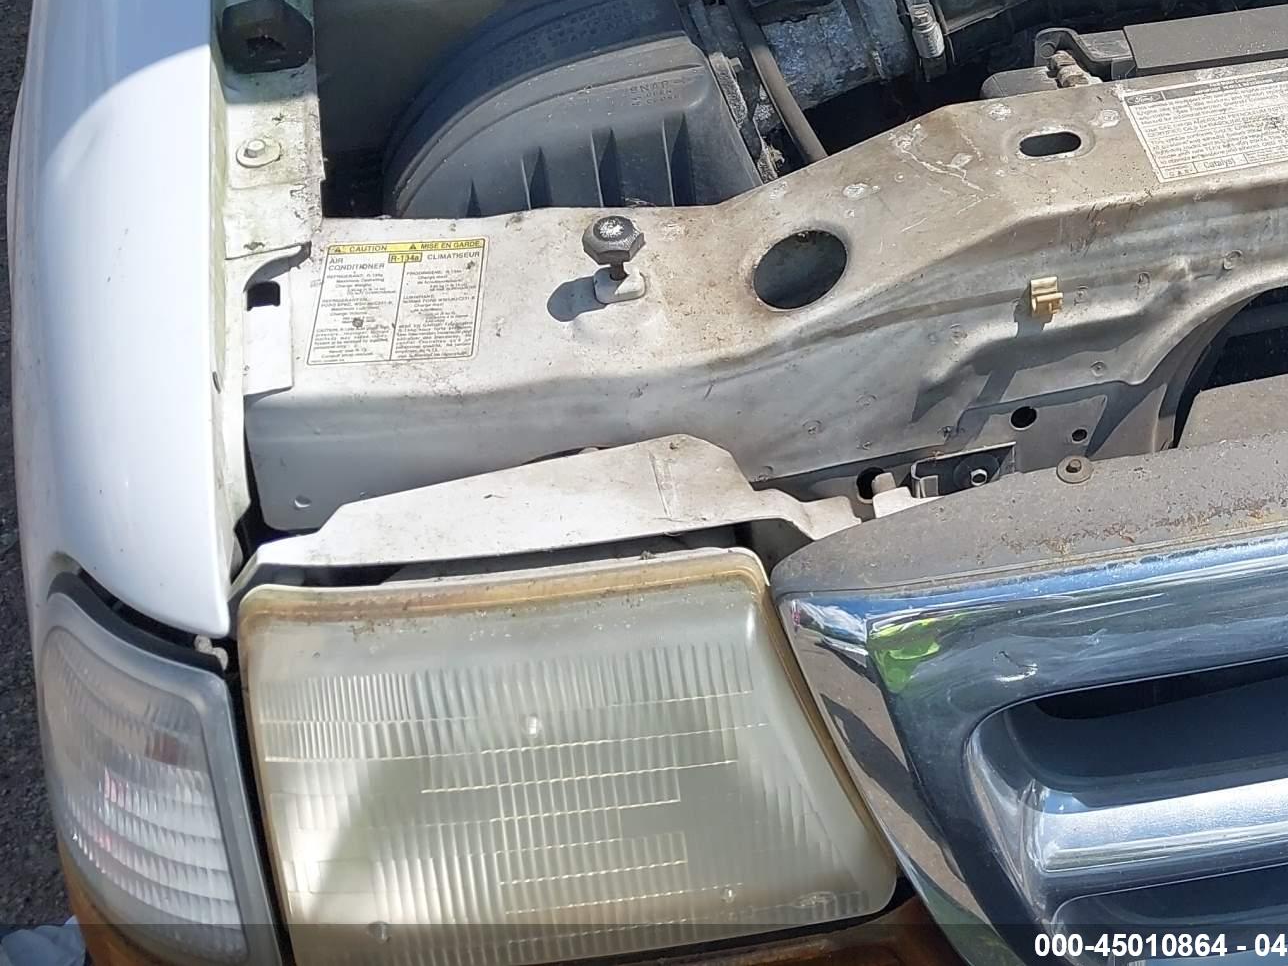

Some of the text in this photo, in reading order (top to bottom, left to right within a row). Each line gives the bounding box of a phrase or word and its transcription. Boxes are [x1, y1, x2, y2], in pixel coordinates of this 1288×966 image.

[349, 244, 388, 253] CAUTION
[420, 239, 481, 250] MISE EN GARDE
[427, 251, 481, 261] CLIMATISEUR
[329, 257, 344, 265] AIR
[328, 263, 385, 272] CONDITIONER
